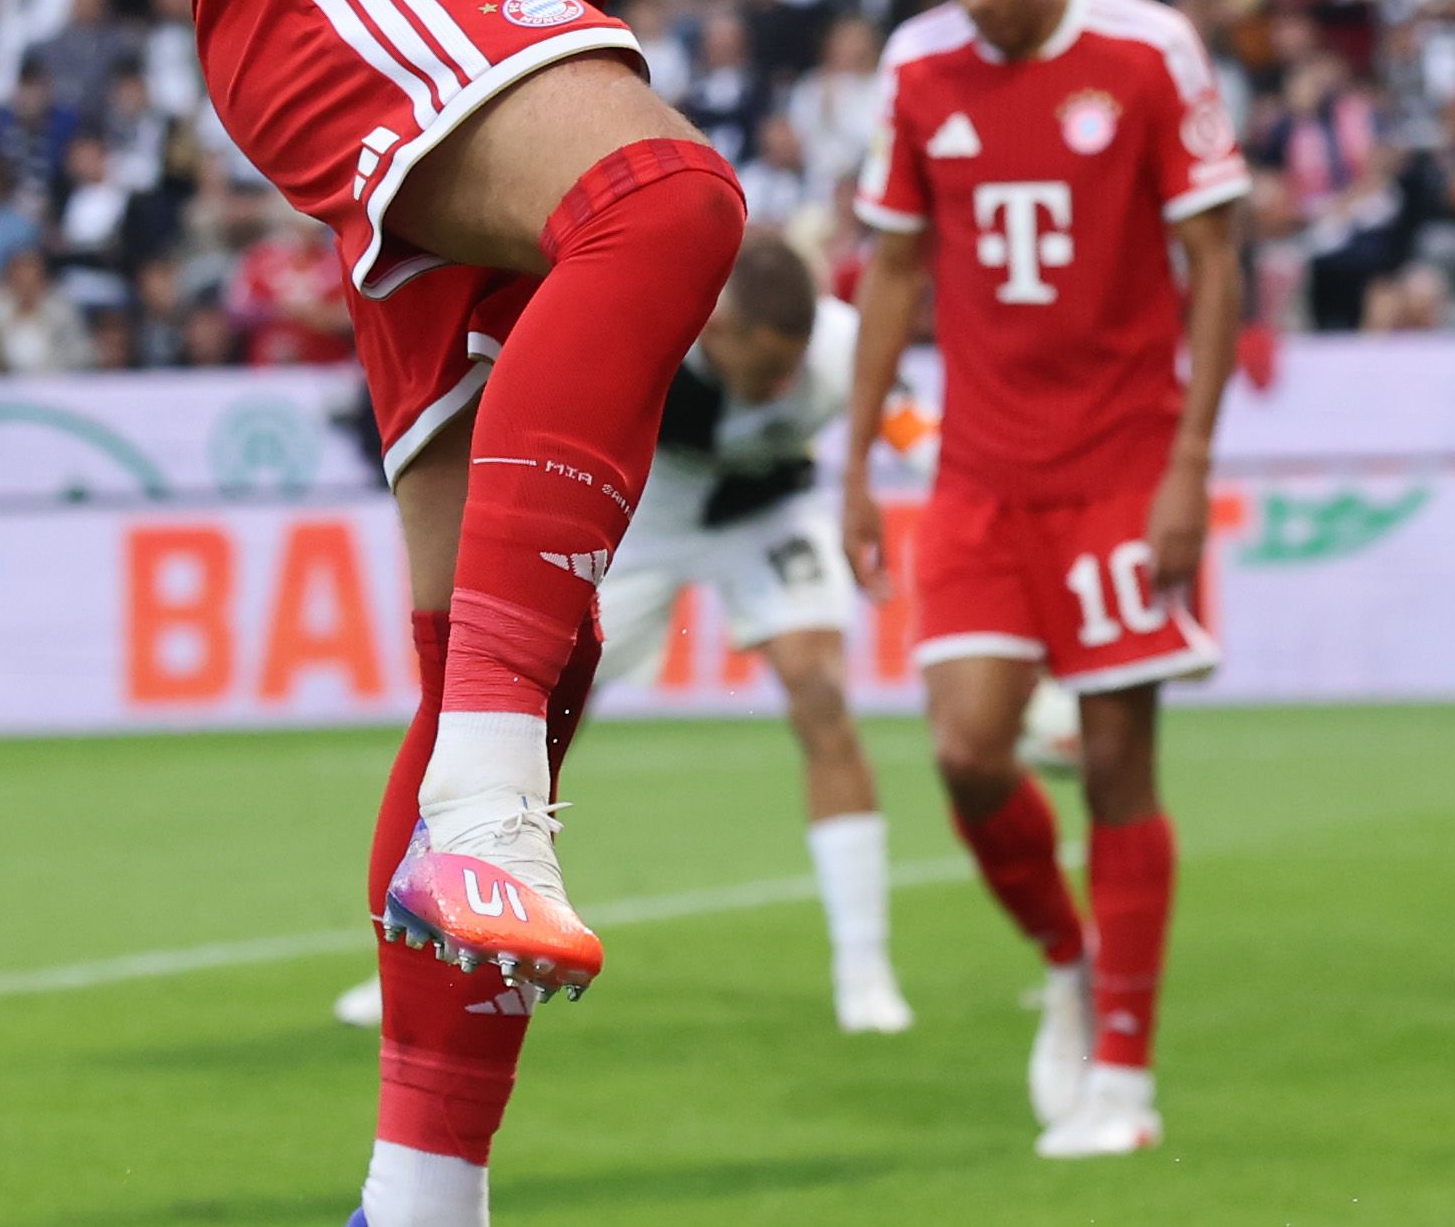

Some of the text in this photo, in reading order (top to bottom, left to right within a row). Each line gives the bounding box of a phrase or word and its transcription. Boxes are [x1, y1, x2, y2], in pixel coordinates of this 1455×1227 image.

[972, 180, 1074, 305] T
[546, 459, 593, 486] MIA
[1066, 540, 1170, 648] 10
